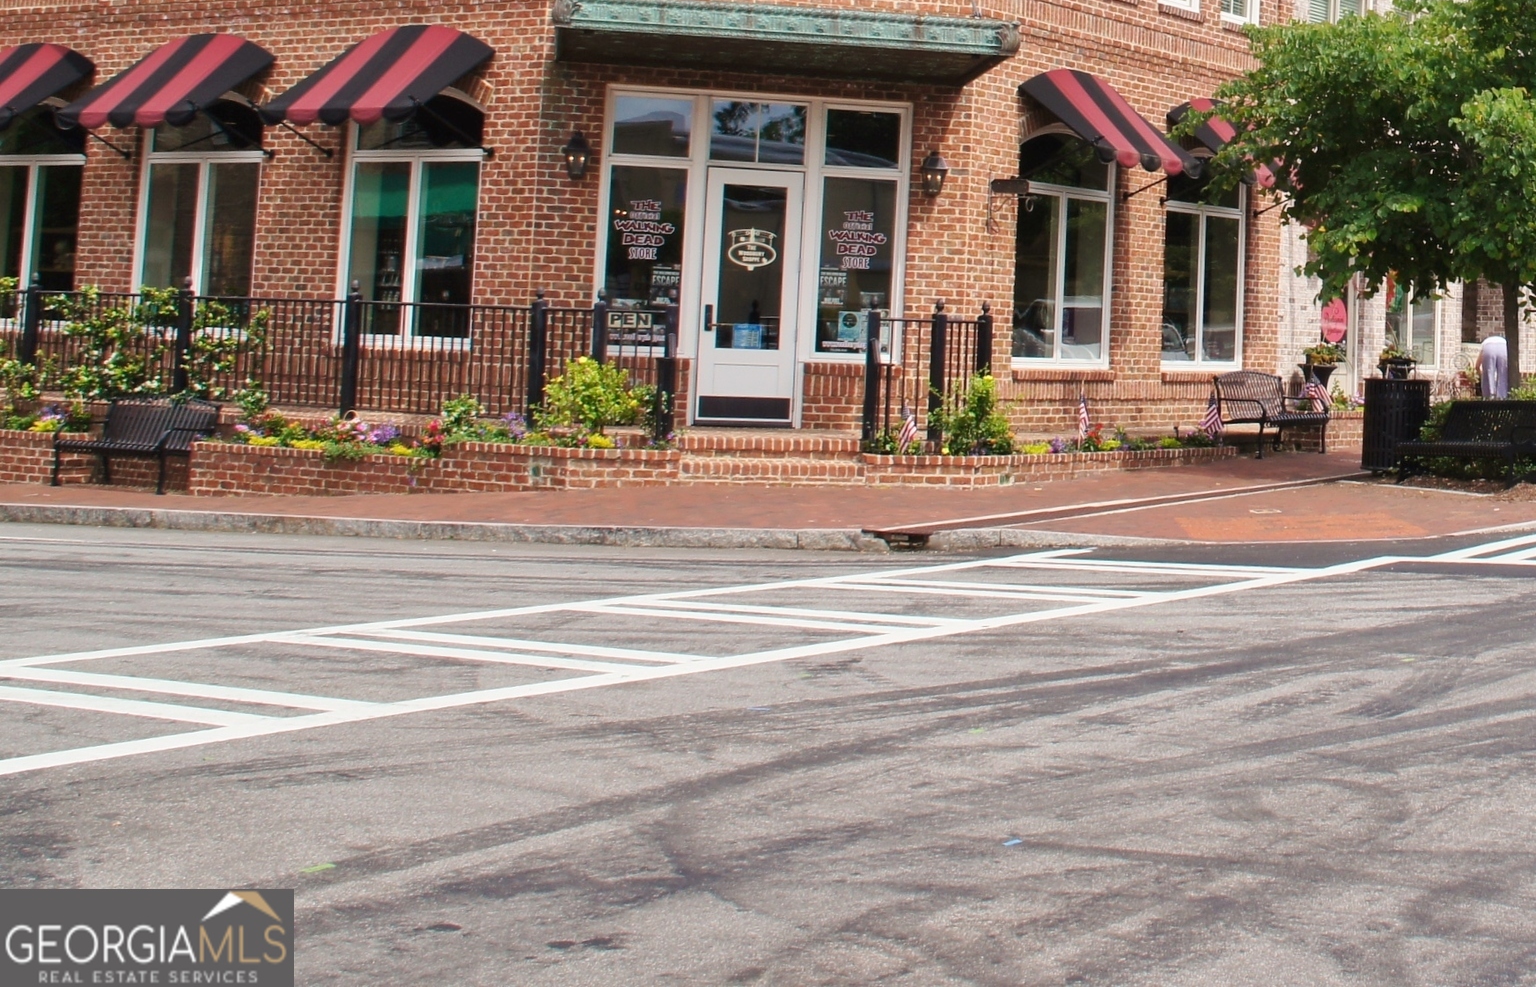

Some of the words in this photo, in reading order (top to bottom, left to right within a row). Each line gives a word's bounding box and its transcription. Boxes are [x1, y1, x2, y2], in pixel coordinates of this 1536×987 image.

[630, 199, 661, 211] THE
[843, 210, 874, 222] THE
[613, 219, 675, 234] WALKING
[622, 233, 665, 247] DEAD
[828, 229, 887, 245] WALKING
[628, 247, 657, 260] STORE
[837, 243, 877, 256] DEAD
[842, 256, 870, 269] STORE
[652, 275, 680, 286] ESCAPE
[820, 276, 847, 287] ESCAPE
[609, 314, 650, 326] PEN
